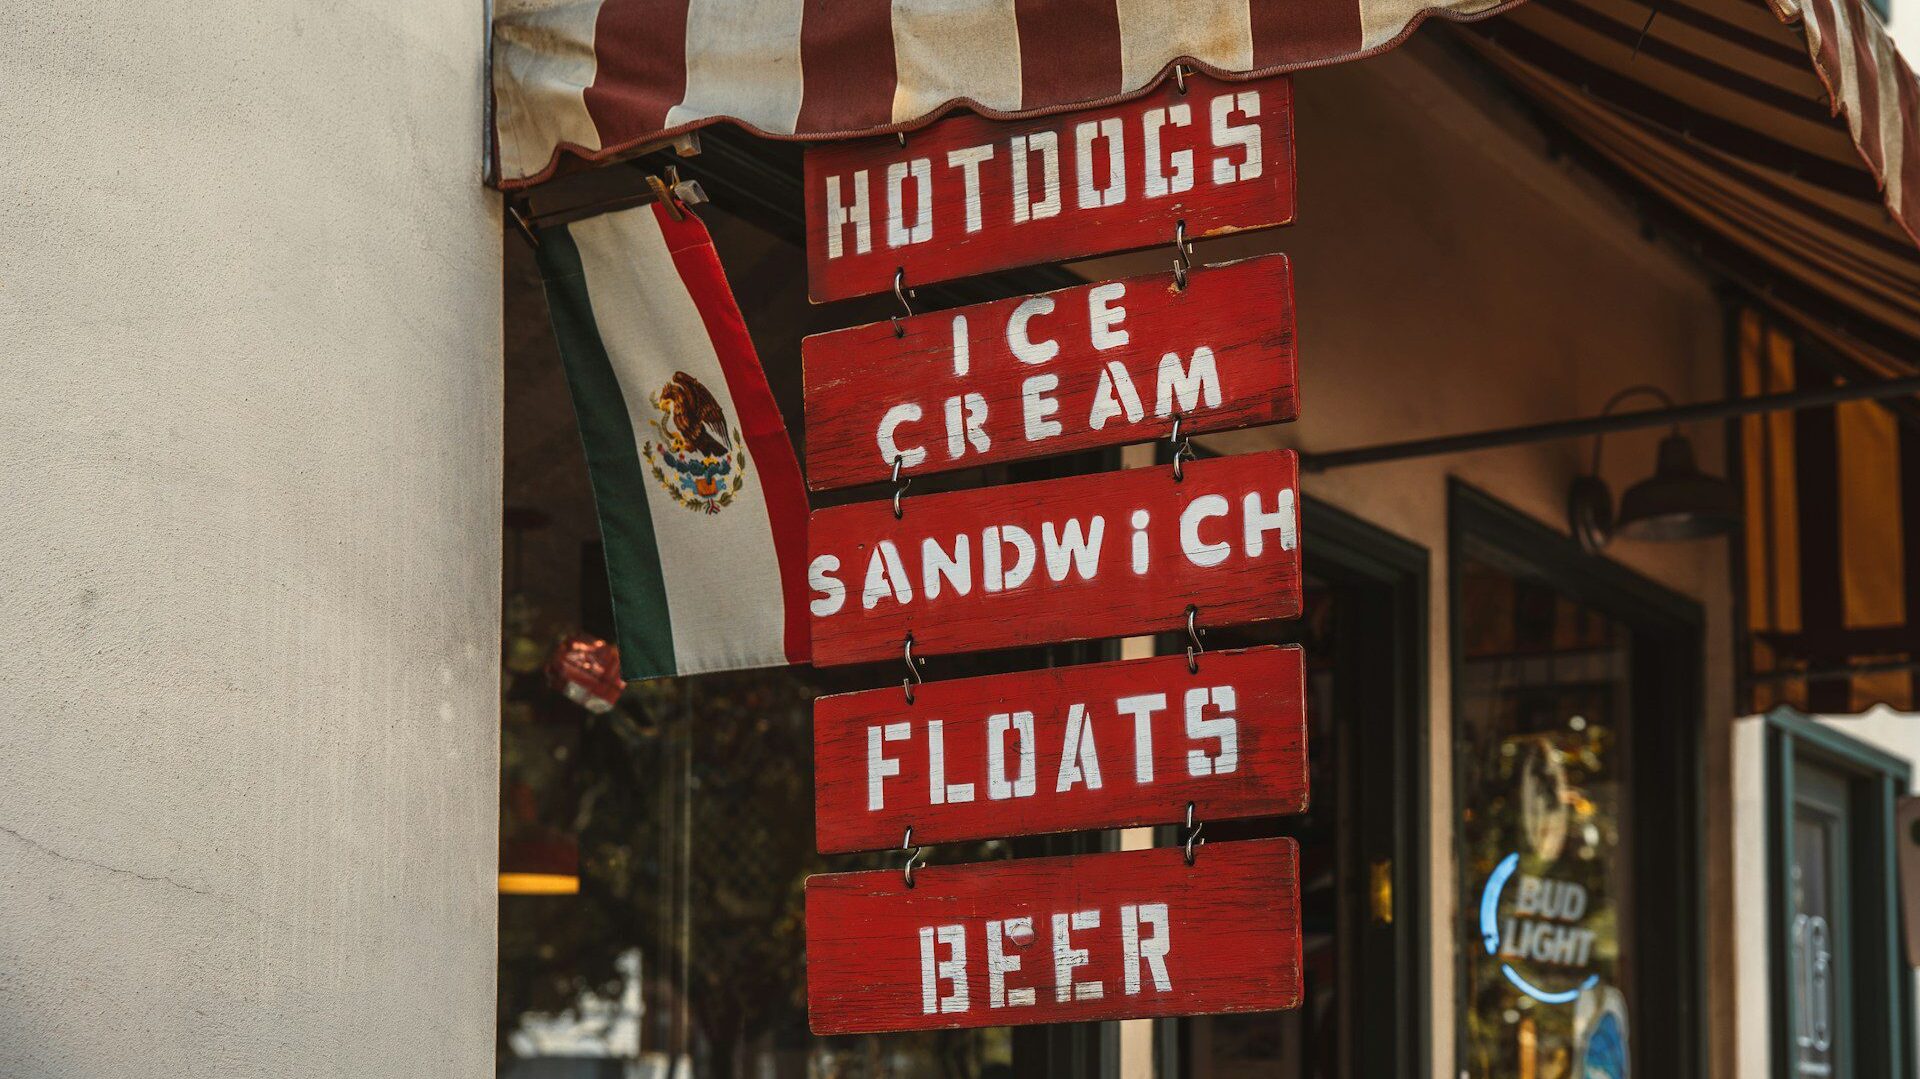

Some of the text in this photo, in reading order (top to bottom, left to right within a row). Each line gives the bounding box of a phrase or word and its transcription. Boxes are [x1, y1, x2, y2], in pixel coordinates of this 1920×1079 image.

[826, 91, 1263, 260] HOTDOGS
[953, 283, 1130, 376] ICE
[876, 346, 1222, 468] CREAM
[867, 685, 1239, 811] FLOATS
[1502, 918, 1595, 966] LIGHT
[1516, 874, 1587, 920] BUD
[919, 903, 1173, 1014] BEER
